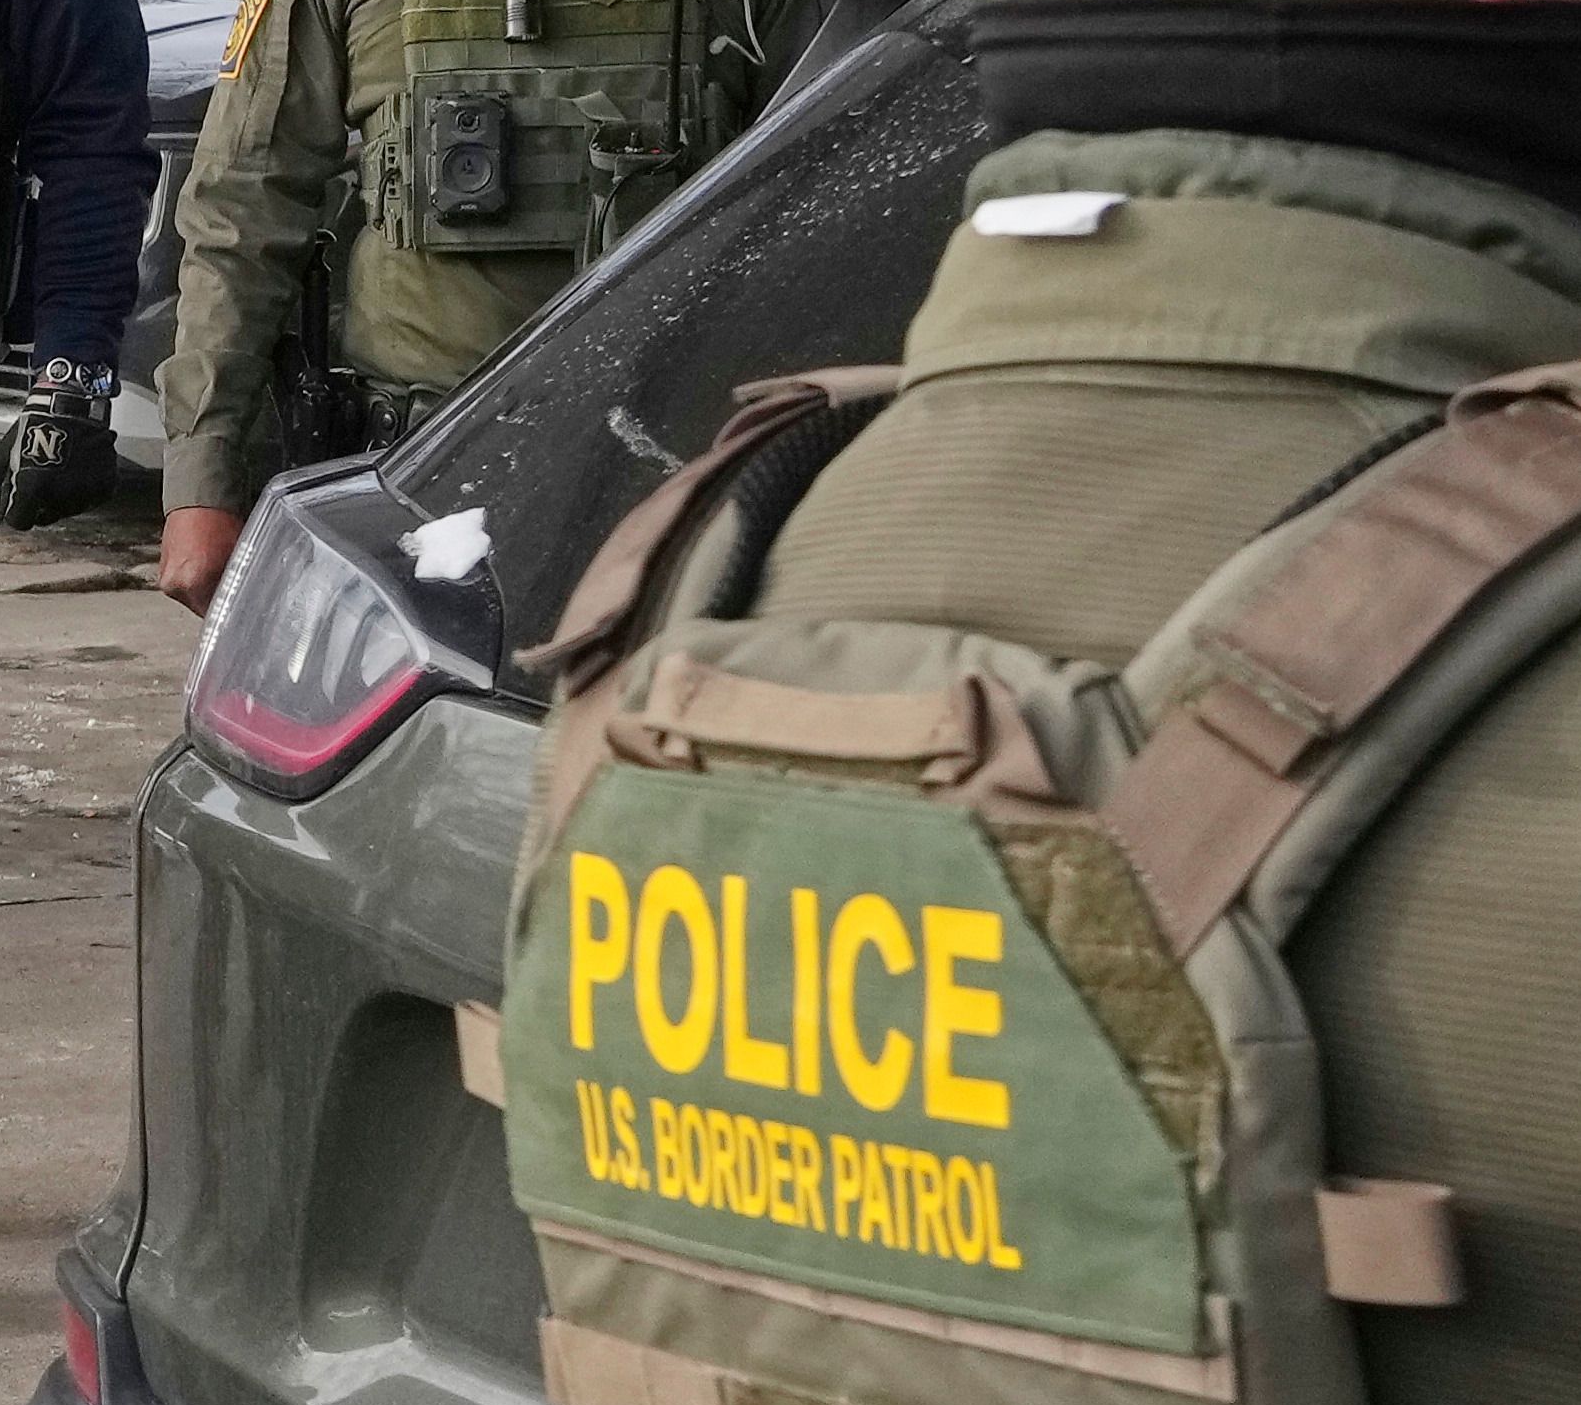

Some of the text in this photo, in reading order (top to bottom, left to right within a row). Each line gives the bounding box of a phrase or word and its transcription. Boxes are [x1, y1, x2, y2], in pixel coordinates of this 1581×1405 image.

[27, 428, 61, 459] N
[569, 851, 1011, 1130] POLICE
[577, 1079, 1023, 1272] U.S. BORDER PATROL
